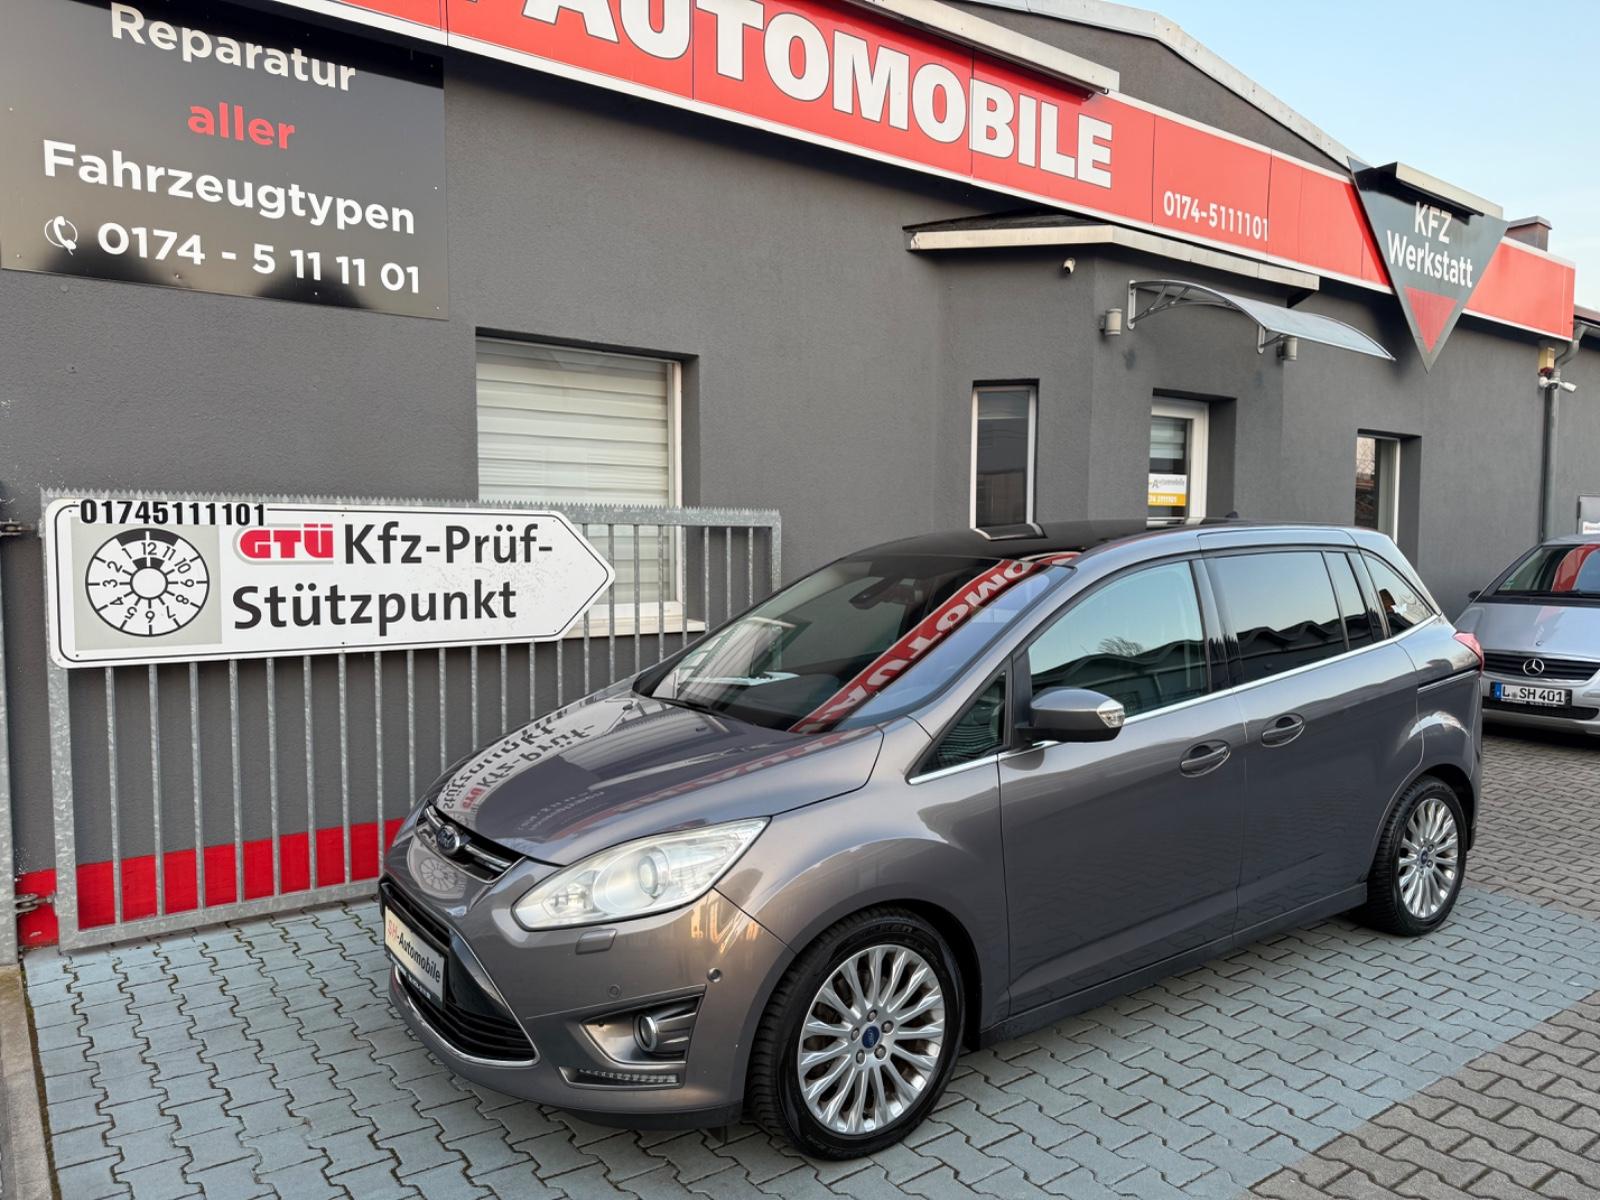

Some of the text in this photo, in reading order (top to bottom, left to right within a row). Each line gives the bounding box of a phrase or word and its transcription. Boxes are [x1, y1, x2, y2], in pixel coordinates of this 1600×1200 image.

[110, 1, 356, 92] Reparatur
[187, 102, 296, 150] aller
[43, 139, 415, 235] Fahrzeugtypen
[1163, 190, 1268, 242] 0174-5111101
[1414, 201, 1453, 244] KFZ
[98, 222, 206, 266] 0174
[252, 243, 276, 275] 5
[290, 249, 321, 281] 11
[336, 256, 366, 287] 11
[380, 261, 419, 294] 01
[1386, 229, 1473, 288] Werkstatt
[80, 498, 265, 527] 01745111101
[239, 520, 553, 565] GTÜ Kfz-Prüf-
[232, 579, 517, 637] Stützpunkt
[1502, 685, 1564, 703] L SH 401
